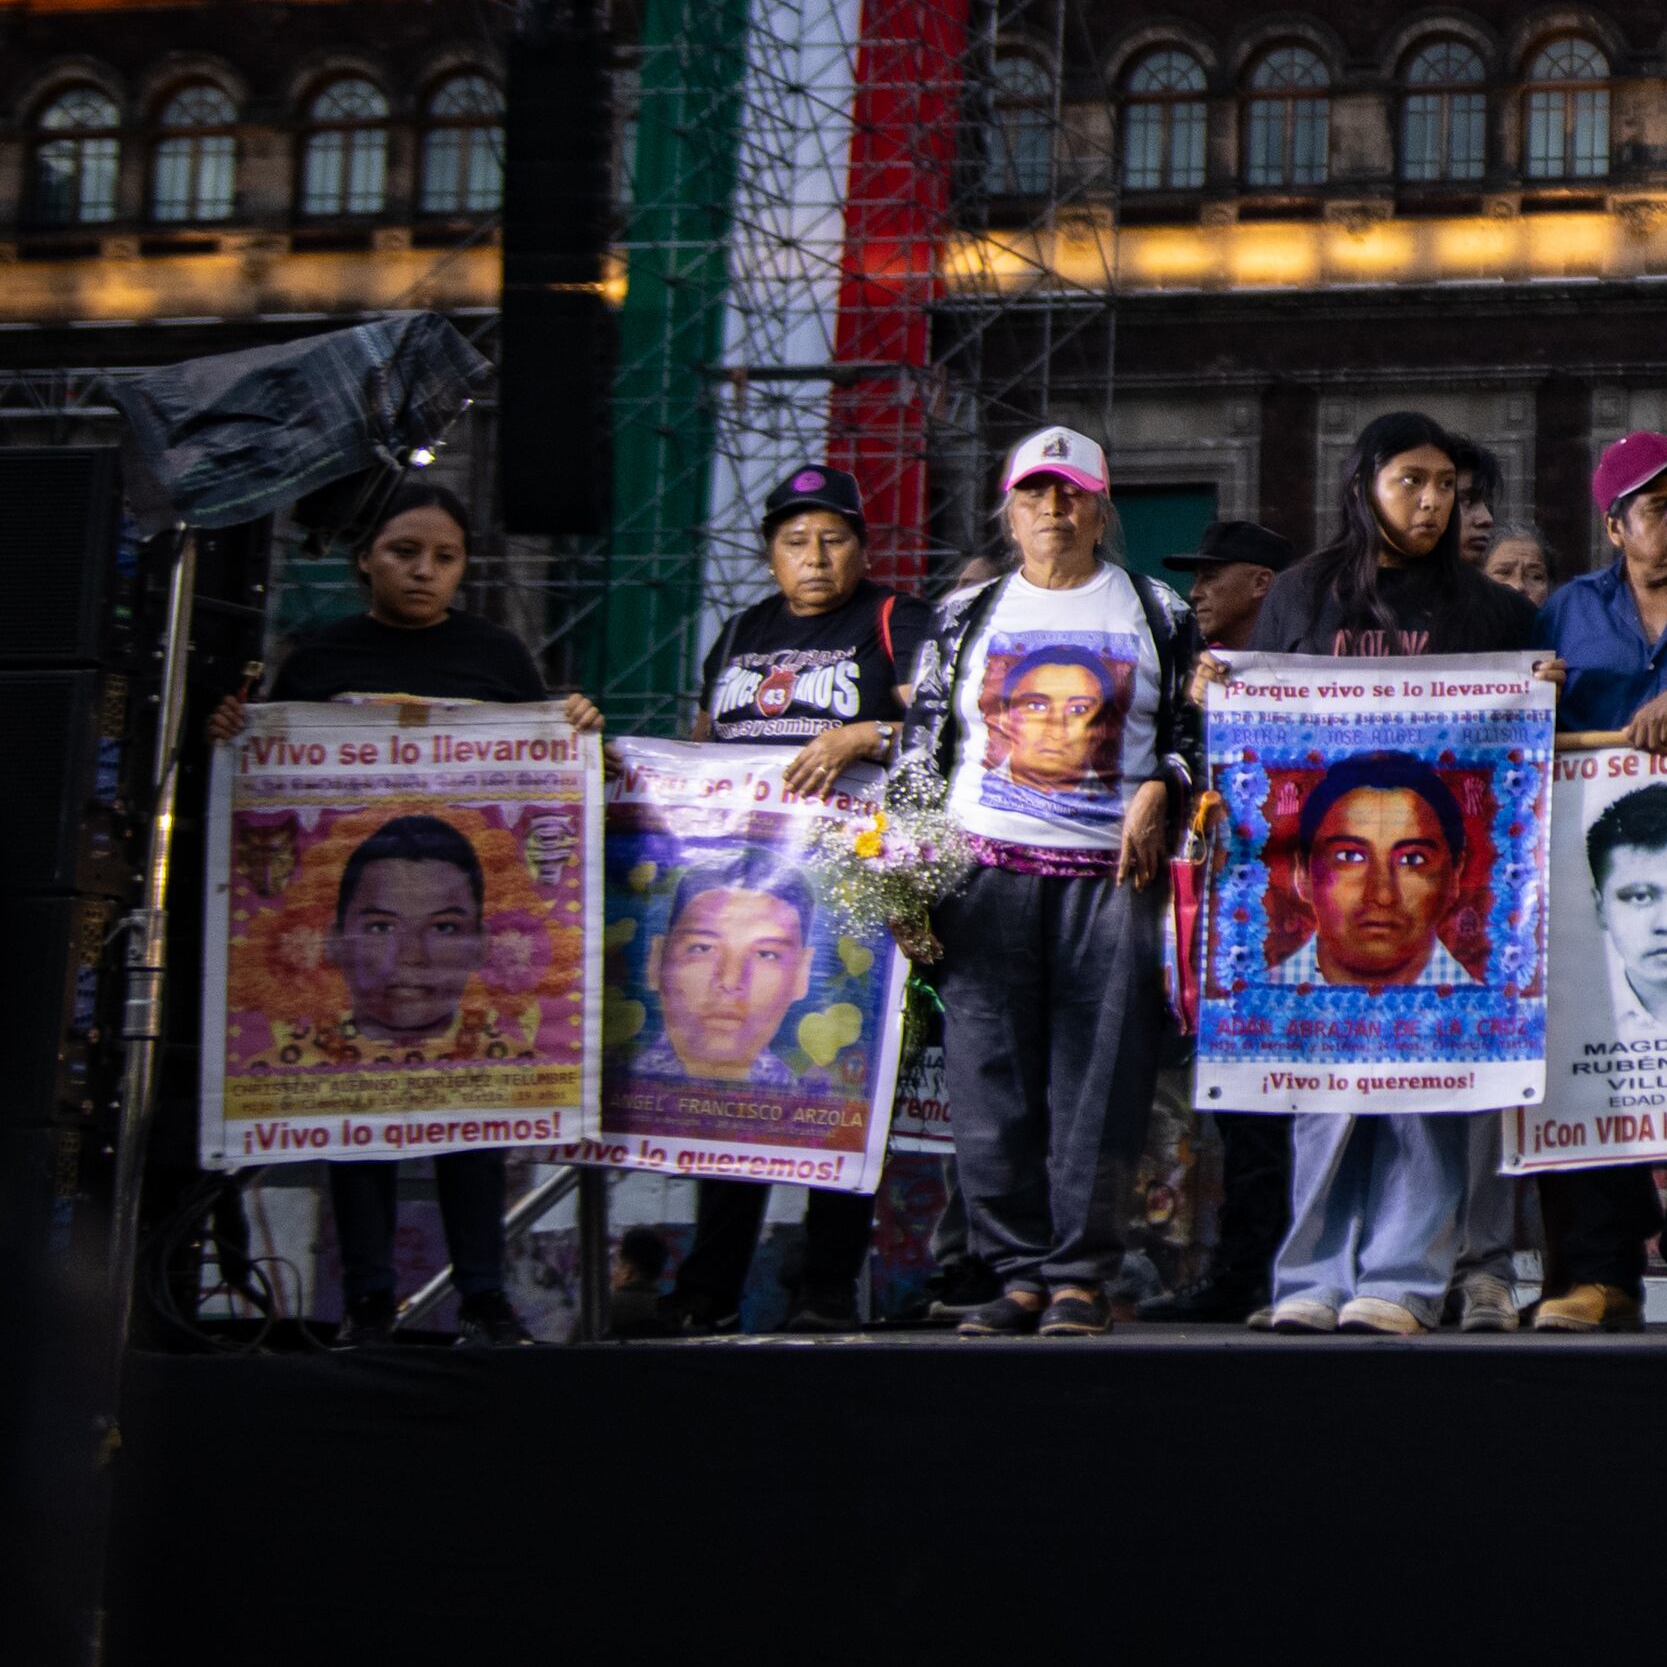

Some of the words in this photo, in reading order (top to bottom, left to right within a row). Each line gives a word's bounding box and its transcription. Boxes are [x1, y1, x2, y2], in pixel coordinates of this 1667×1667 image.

[763, 688, 786, 705] 43
[1224, 681, 1309, 701] ¡Porque
[1317, 683, 1365, 698] vivo
[1372, 684, 1395, 697] se
[1403, 681, 1424, 697] lo
[1430, 680, 1530, 697] llevaron!
[240, 735, 326, 773] ¡Vivo
[338, 741, 378, 765] se
[390, 735, 420, 765] lo
[432, 733, 580, 764] llevaron!
[1554, 753, 1598, 782] ivo
[1607, 754, 1639, 778] se
[1394, 1020, 1421, 1037] DE
[1436, 1020, 1463, 1037] LA
[1477, 1017, 1529, 1037] CRUZ
[1262, 1072, 1320, 1094] ¡Vivo
[1328, 1073, 1349, 1091] lo
[1356, 1072, 1475, 1095] queremos!
[678, 1098, 783, 1121] FRANCISCO
[792, 1106, 863, 1127] ARZOLA
[1609, 1093, 1665, 1108] EDAD
[243, 1122, 329, 1155] ¡Vivo
[342, 1119, 372, 1146] lo
[384, 1111, 562, 1152] queremos!
[1534, 1118, 1587, 1151] ¡Con
[1595, 1113, 1656, 1145] VIDA
[641, 1140, 667, 1168] lo
[676, 1148, 846, 1181] queremos!
